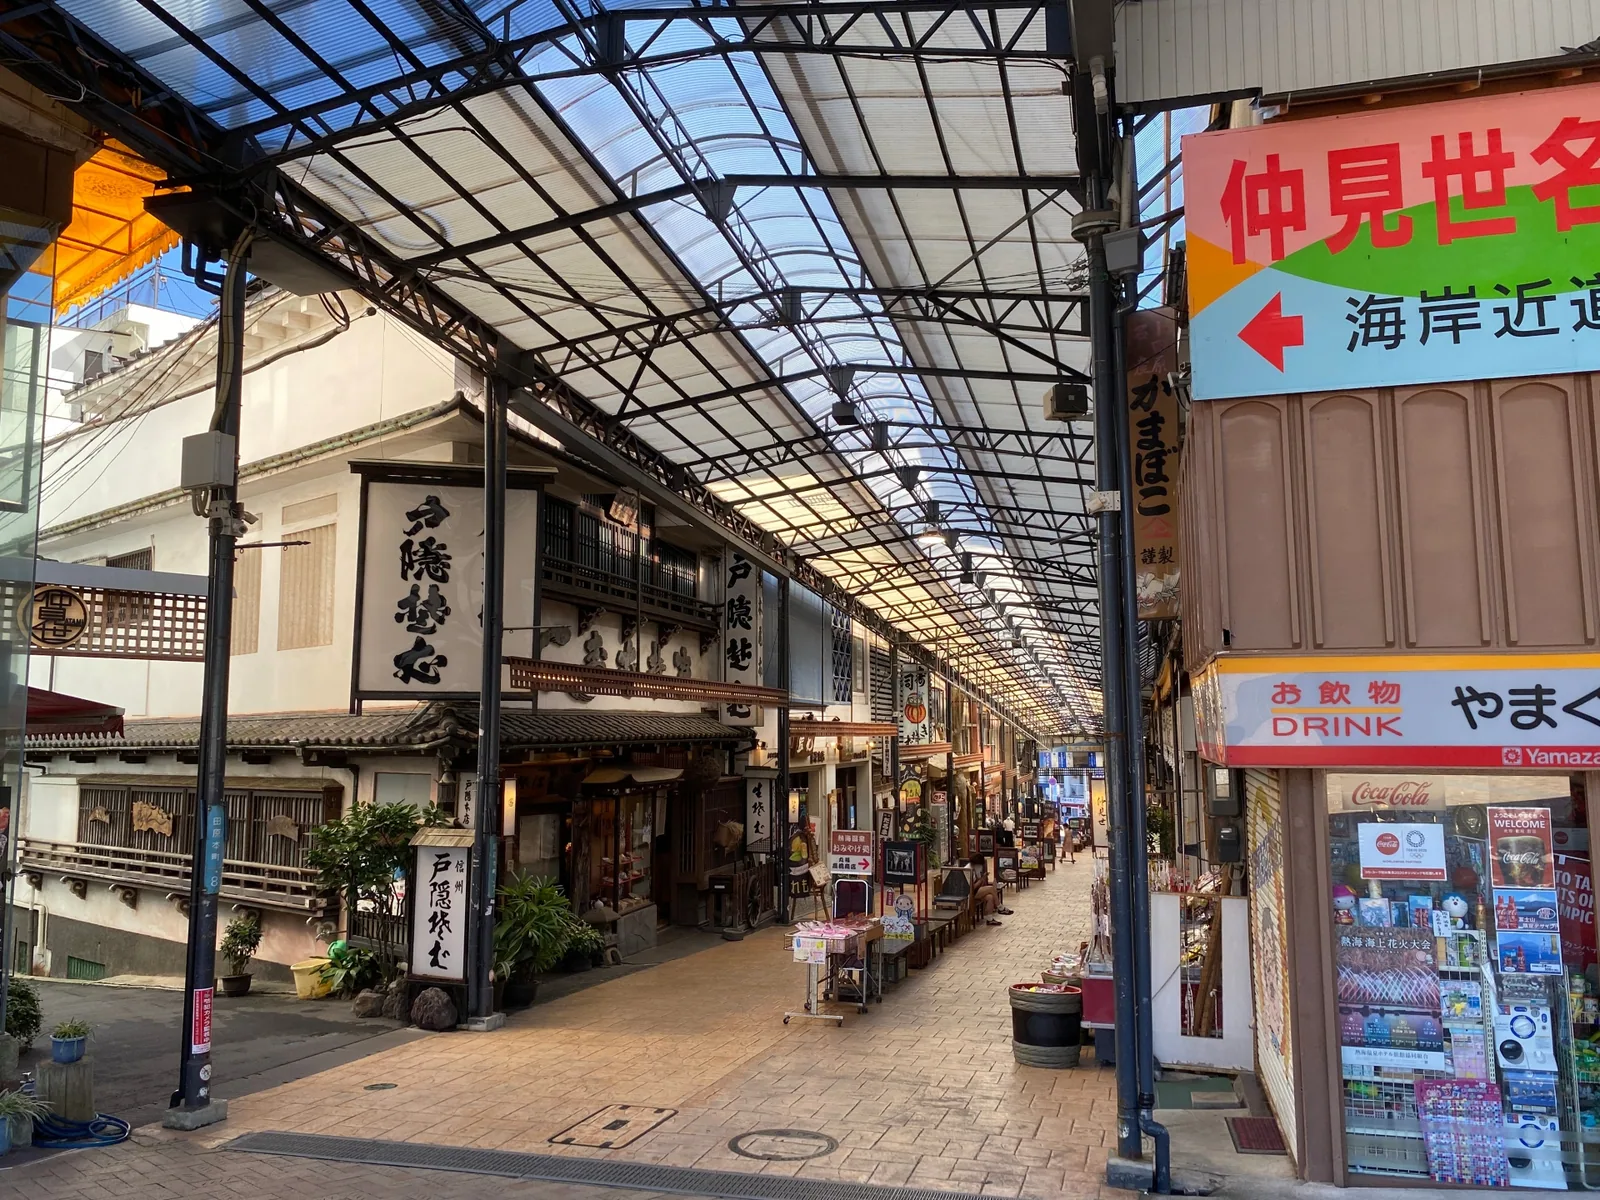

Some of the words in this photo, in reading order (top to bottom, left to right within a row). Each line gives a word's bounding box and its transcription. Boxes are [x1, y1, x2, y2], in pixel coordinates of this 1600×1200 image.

[1130, 374, 1179, 517] かまぼこ
[1140, 545, 1175, 566] 謹製
[1271, 680, 1402, 705] お飲物
[1272, 716, 1403, 737] DRINK
[1494, 820, 1546, 829] WELCOME
[213, 816, 222, 861] 田原本町
[833, 844, 870, 854] おみやげ処
[454, 860, 464, 894] 信州
[1575, 874, 1592, 891] TA
[1559, 902, 1594, 924] MPIC
[1365, 937, 1431, 950] 海上花火大会
